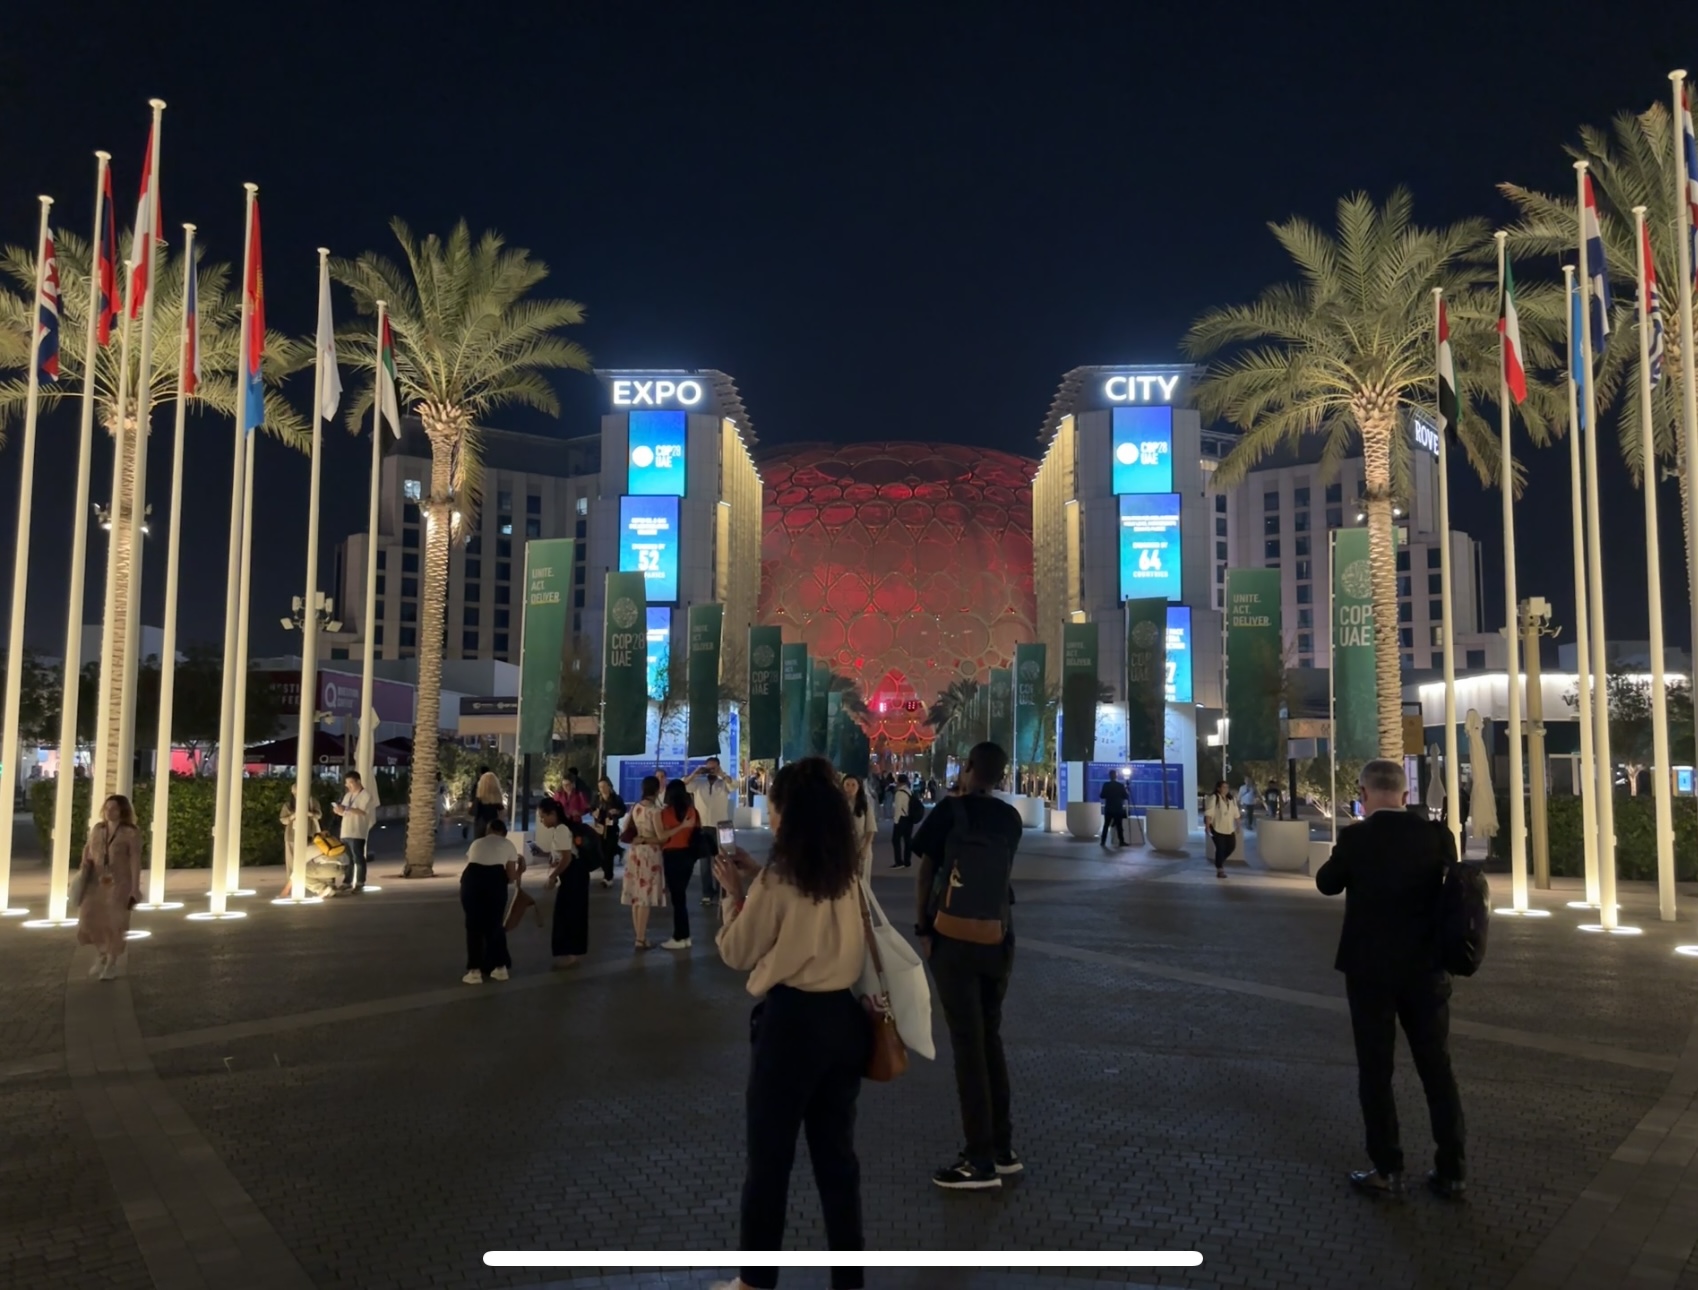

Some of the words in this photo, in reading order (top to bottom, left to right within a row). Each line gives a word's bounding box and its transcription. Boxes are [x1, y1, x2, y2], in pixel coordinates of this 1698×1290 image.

[613, 380, 702, 405] EXPO
[1105, 375, 1179, 401] CITY
[1415, 420, 1439, 456] ROVE
[638, 550, 660, 571] 52
[1139, 549, 1162, 571] 64
[1233, 594, 1262, 604] UNITE.
[1232, 605, 1251, 615] ACT.
[1232, 616, 1272, 627] DELIVER.
[611, 633, 645, 651] COP28
[1339, 625, 1371, 647] UAE
[611, 650, 632, 667] UAE
